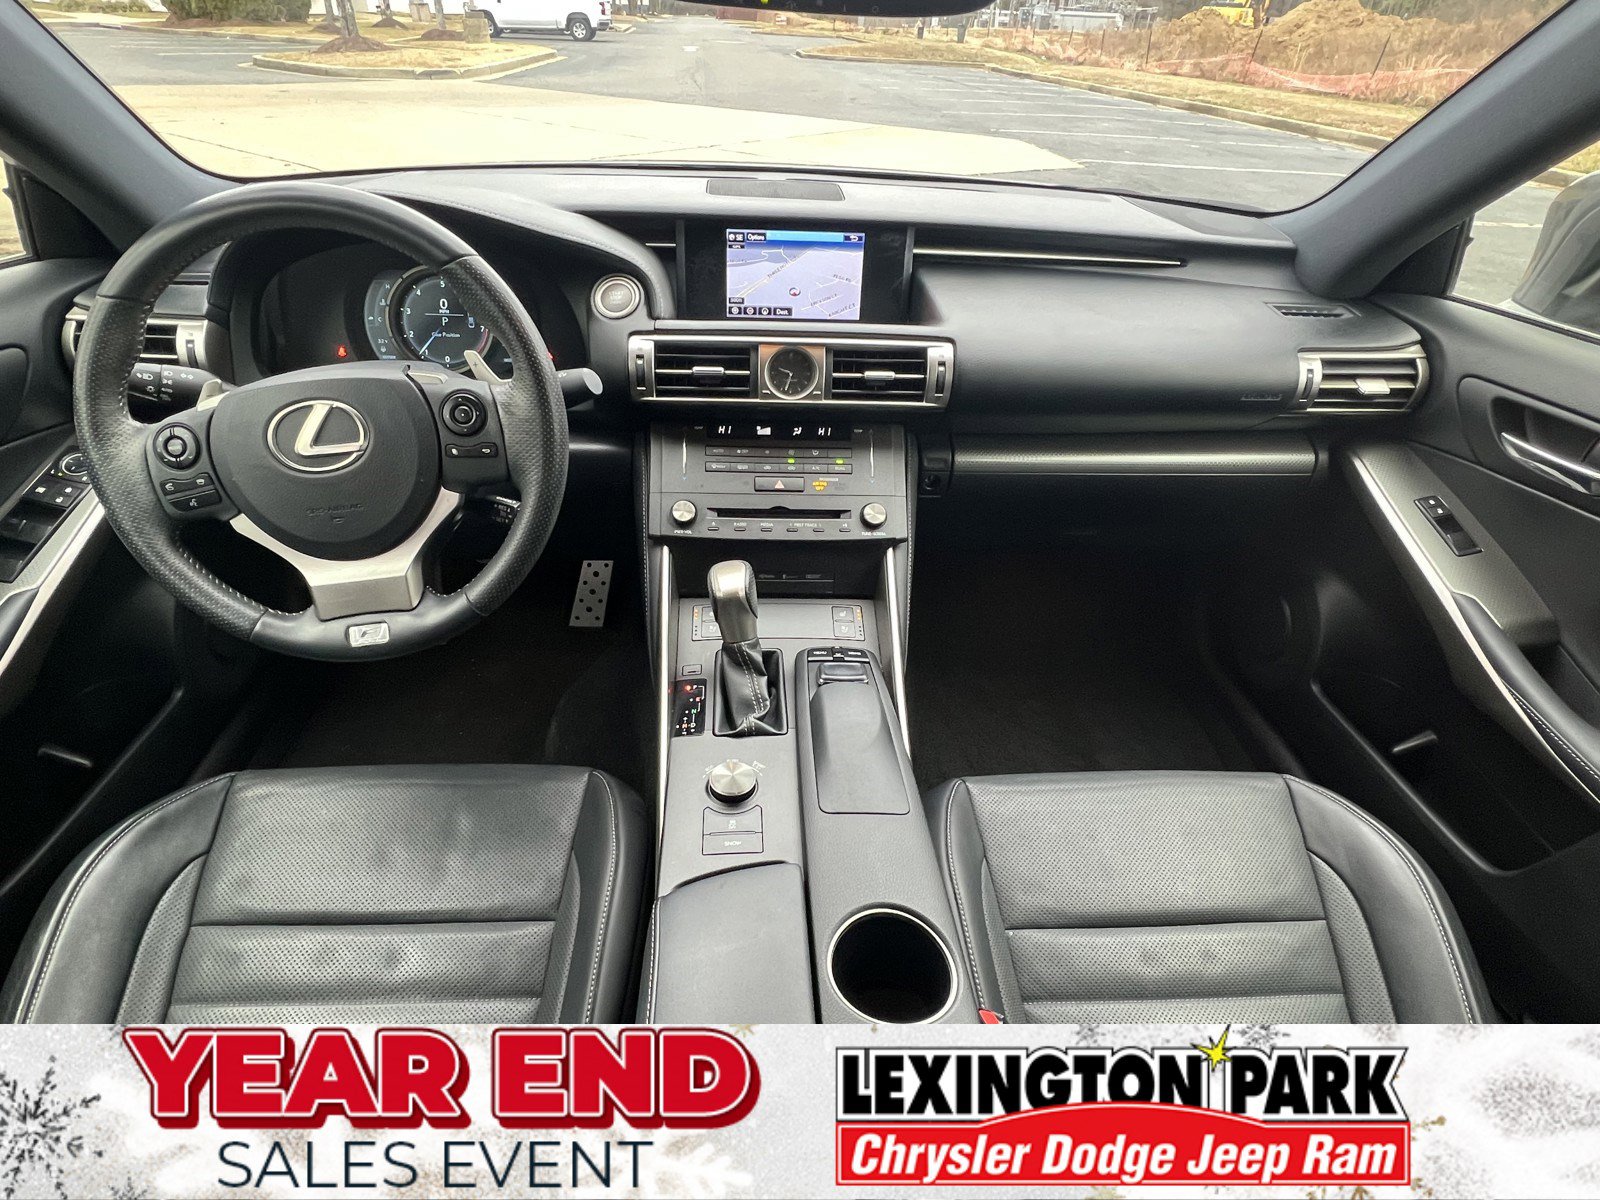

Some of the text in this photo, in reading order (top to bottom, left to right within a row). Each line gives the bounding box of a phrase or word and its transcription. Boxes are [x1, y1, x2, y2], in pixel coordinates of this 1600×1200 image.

[747, 233, 765, 242] Options
[442, 317, 449, 326] P
[718, 425, 732, 434] HI
[818, 427, 831, 436] HI
